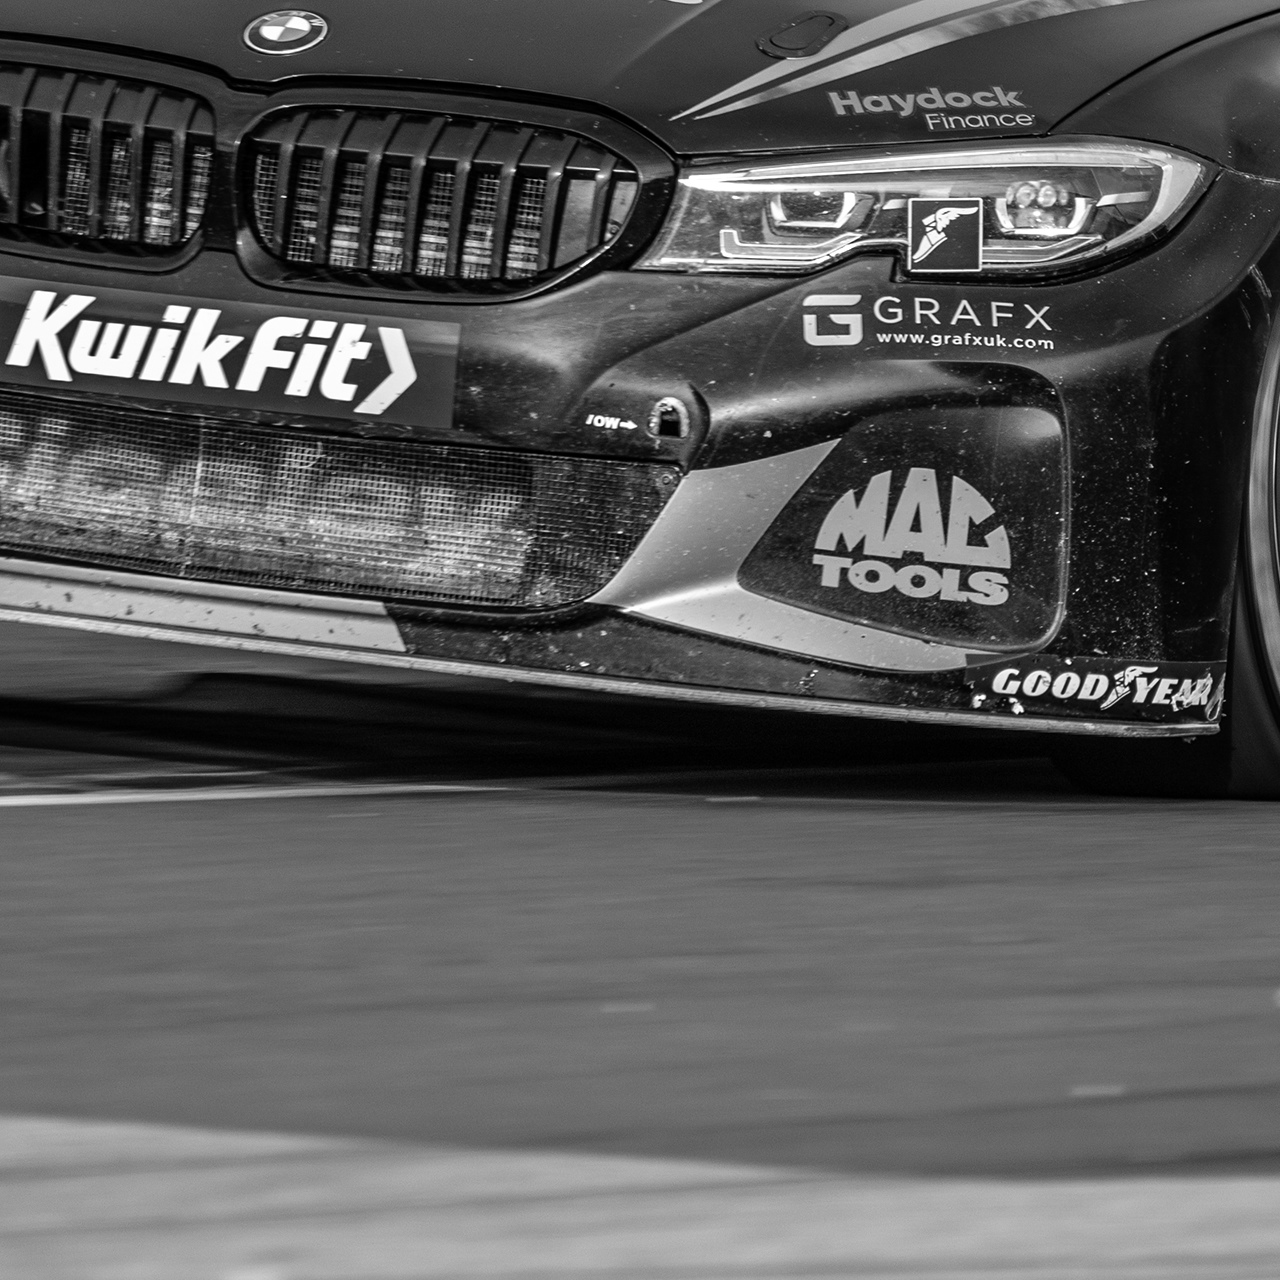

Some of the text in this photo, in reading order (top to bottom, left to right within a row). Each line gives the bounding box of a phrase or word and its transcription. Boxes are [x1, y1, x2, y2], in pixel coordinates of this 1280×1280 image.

[828, 86, 1025, 116] Haydock
[925, 113, 1034, 130] Finance
[873, 295, 1053, 331] GRAFX
[876, 331, 1055, 350] www.grafxuk.com
[814, 467, 1011, 569] MAC
[812, 554, 1010, 607] TOOLS
